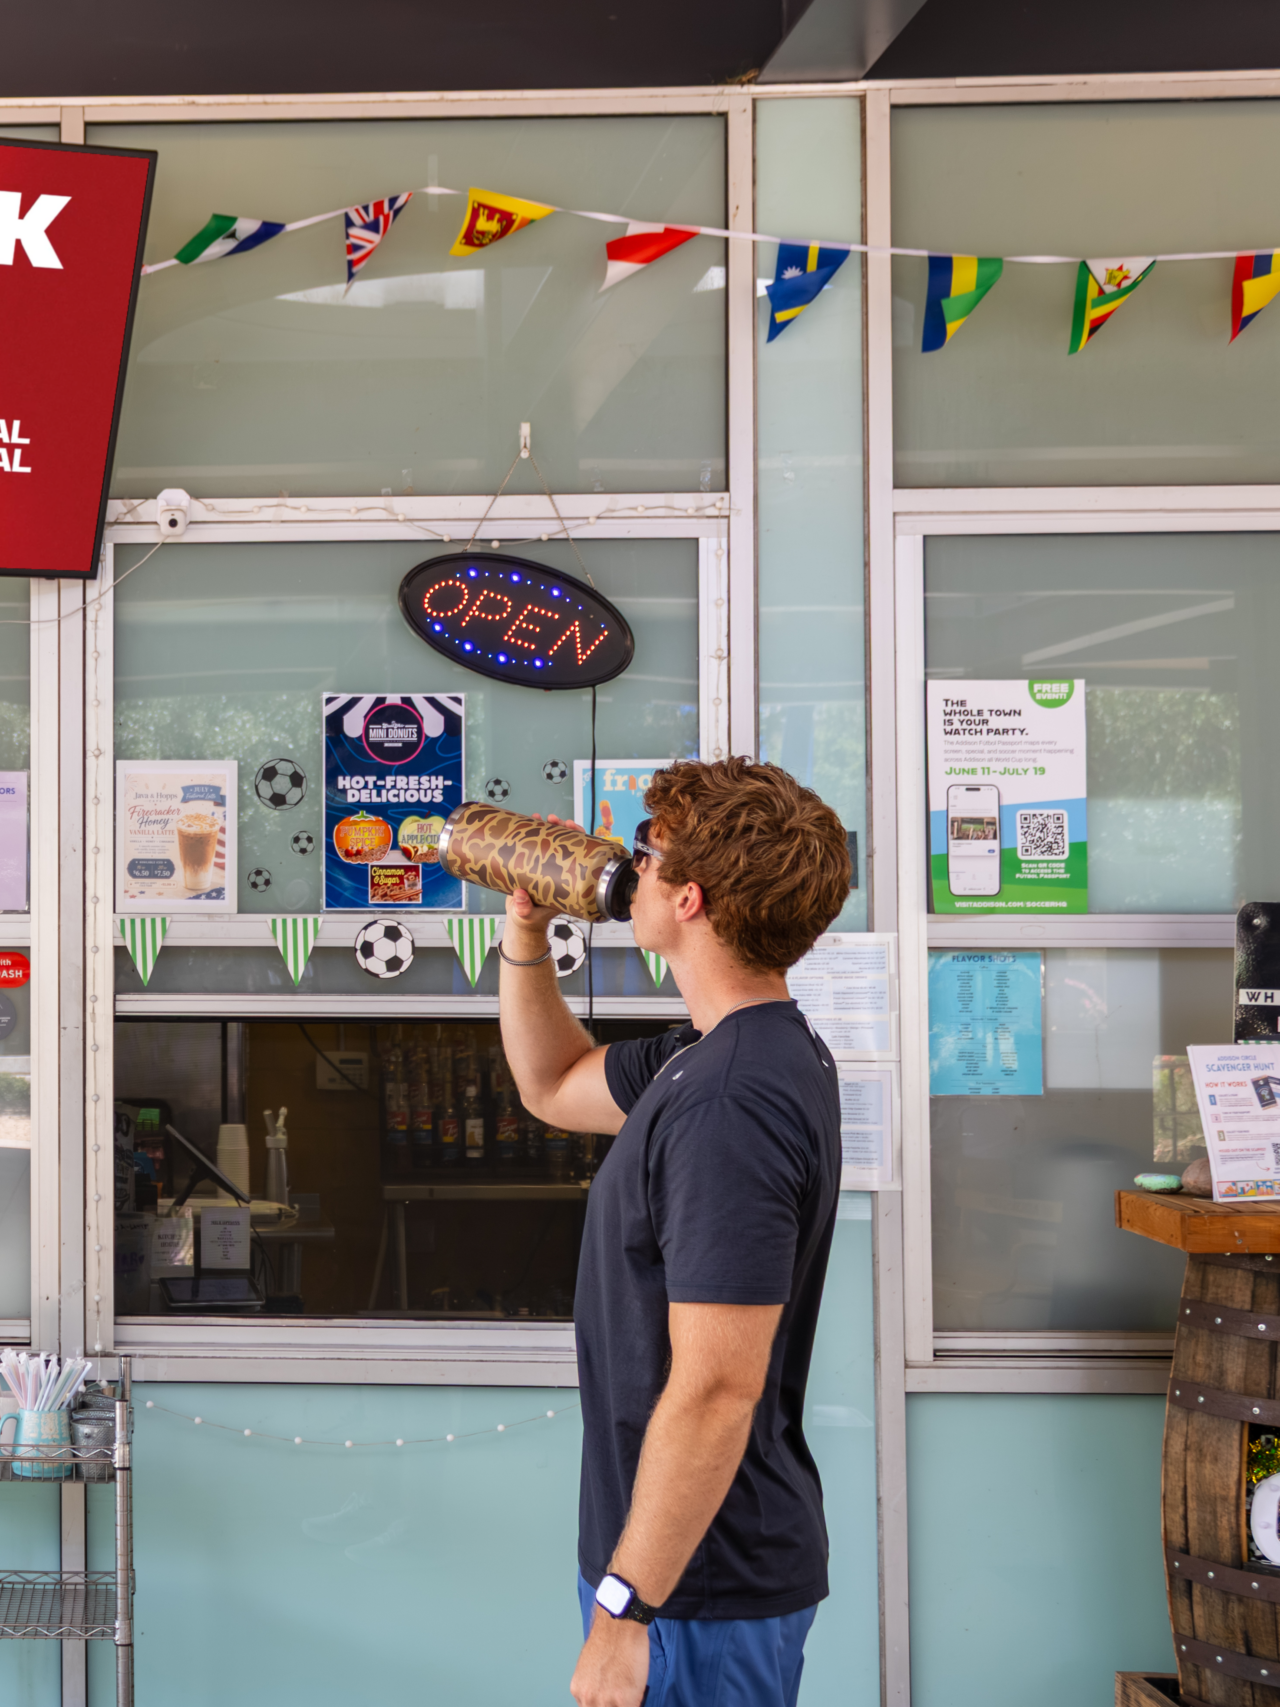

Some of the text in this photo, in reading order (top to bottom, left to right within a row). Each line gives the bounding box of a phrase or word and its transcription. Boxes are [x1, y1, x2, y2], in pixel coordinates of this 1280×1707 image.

[424, 579, 609, 665] OPEN
[1034, 683, 1069, 693] FREE
[943, 698, 967, 707] THE
[943, 709, 984, 717] WHOLE
[369, 728, 418, 738] MINI DONUTS
[943, 728, 1029, 736] WATCH PARTY.
[945, 767, 1046, 776] JUNE 19
[338, 775, 453, 789] HOT-FRESH-
[134, 792, 178, 800] Java Hopps
[347, 789, 444, 803] DELICIOUS
[128, 805, 181, 820] Firecracker
[137, 816, 170, 830] Honey
[340, 826, 385, 837] PUMPKIN
[417, 823, 433, 834] HOT
[349, 836, 376, 847] SPICE
[401, 834, 425, 844] APPLE
[371, 867, 405, 876] Cinnamon
[1206, 1063, 1252, 1072] SCAVENGER
